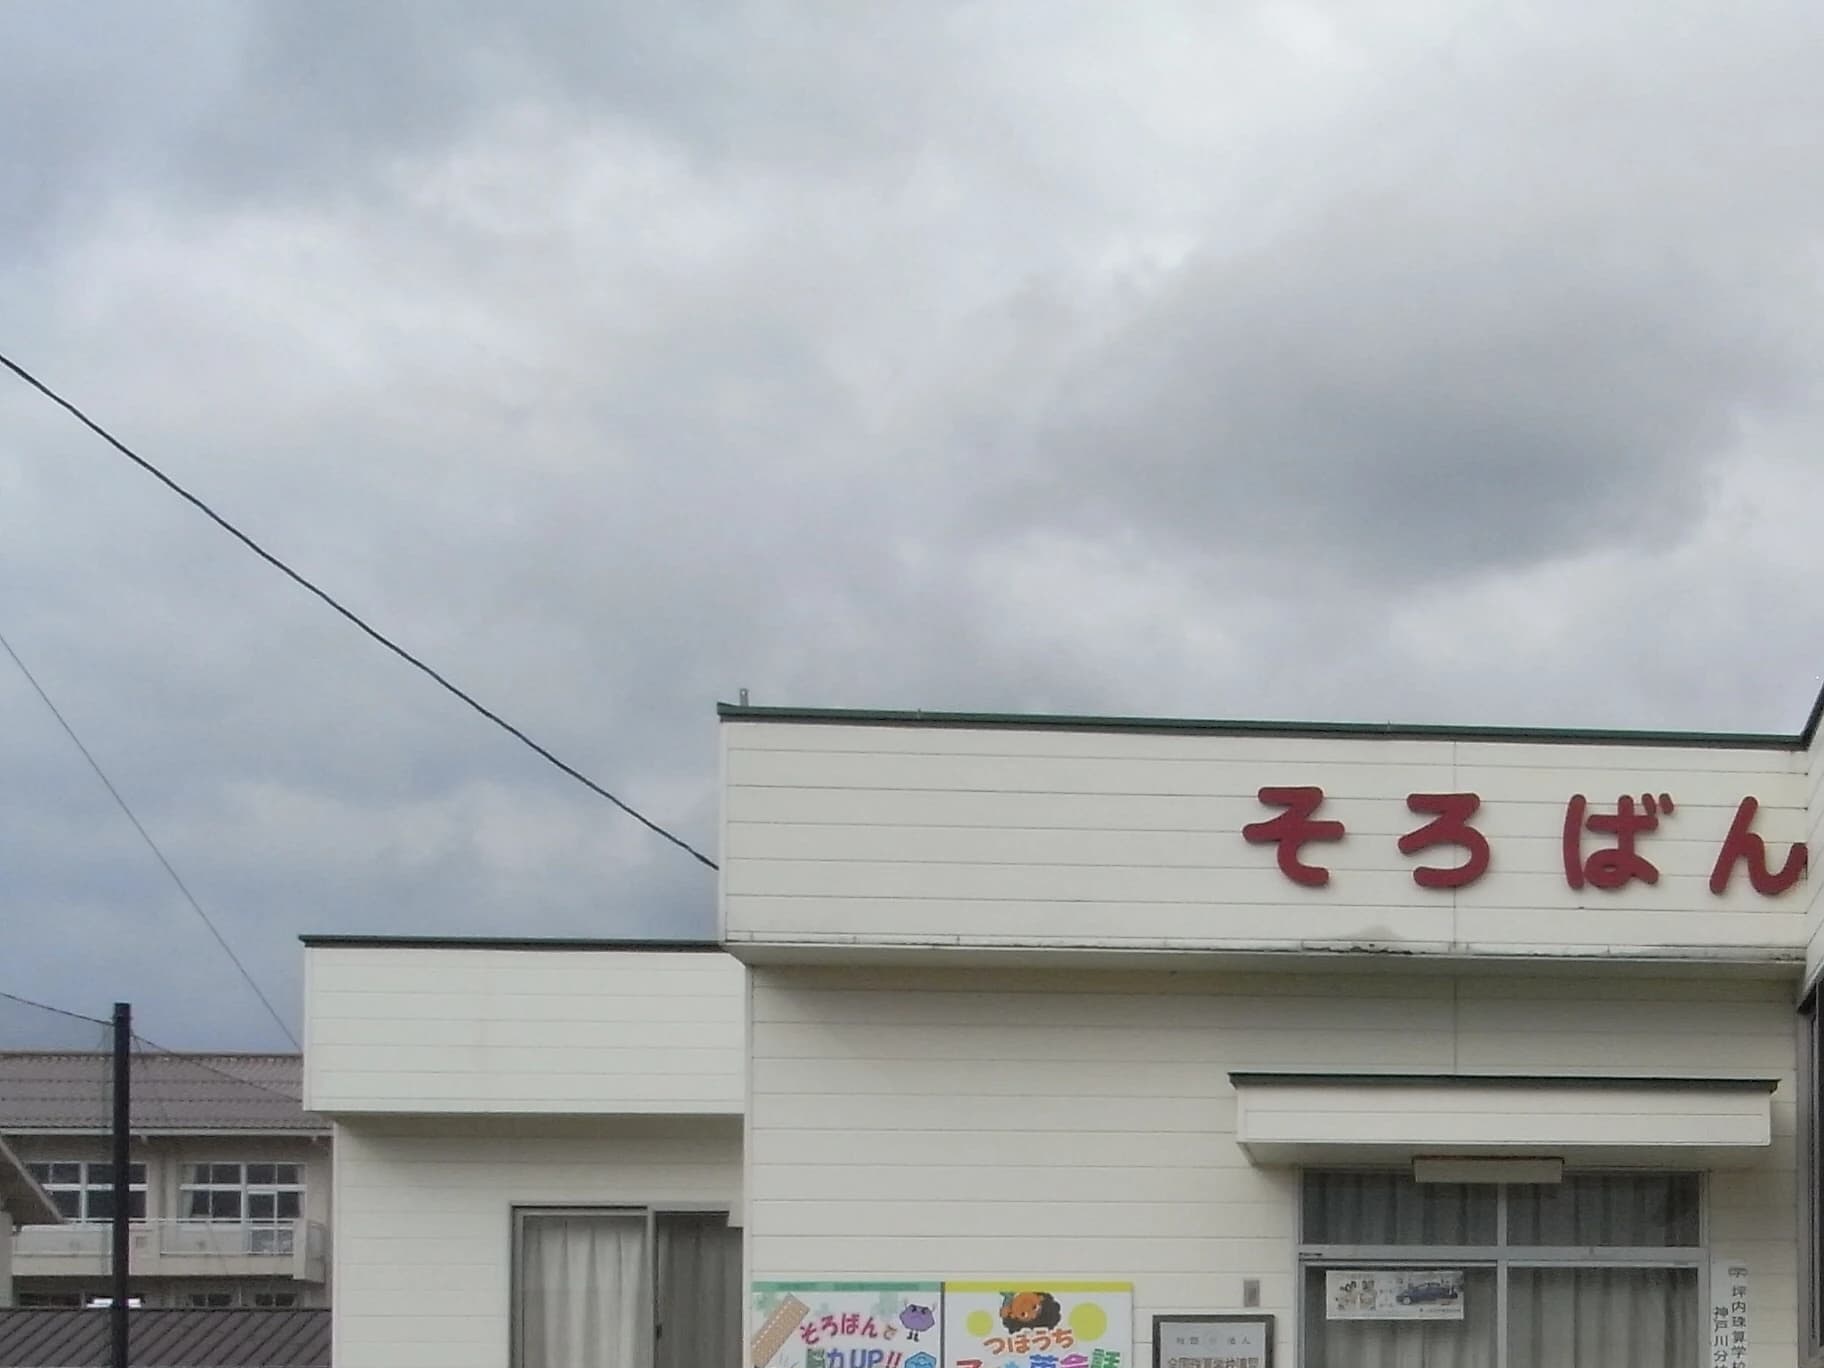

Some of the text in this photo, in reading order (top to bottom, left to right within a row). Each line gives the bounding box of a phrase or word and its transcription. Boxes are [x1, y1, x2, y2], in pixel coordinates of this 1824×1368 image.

[1242, 786, 1808, 895] そろばん
[800, 1313, 898, 1345] そろばんで
[983, 1328, 1075, 1354] つぼうち
